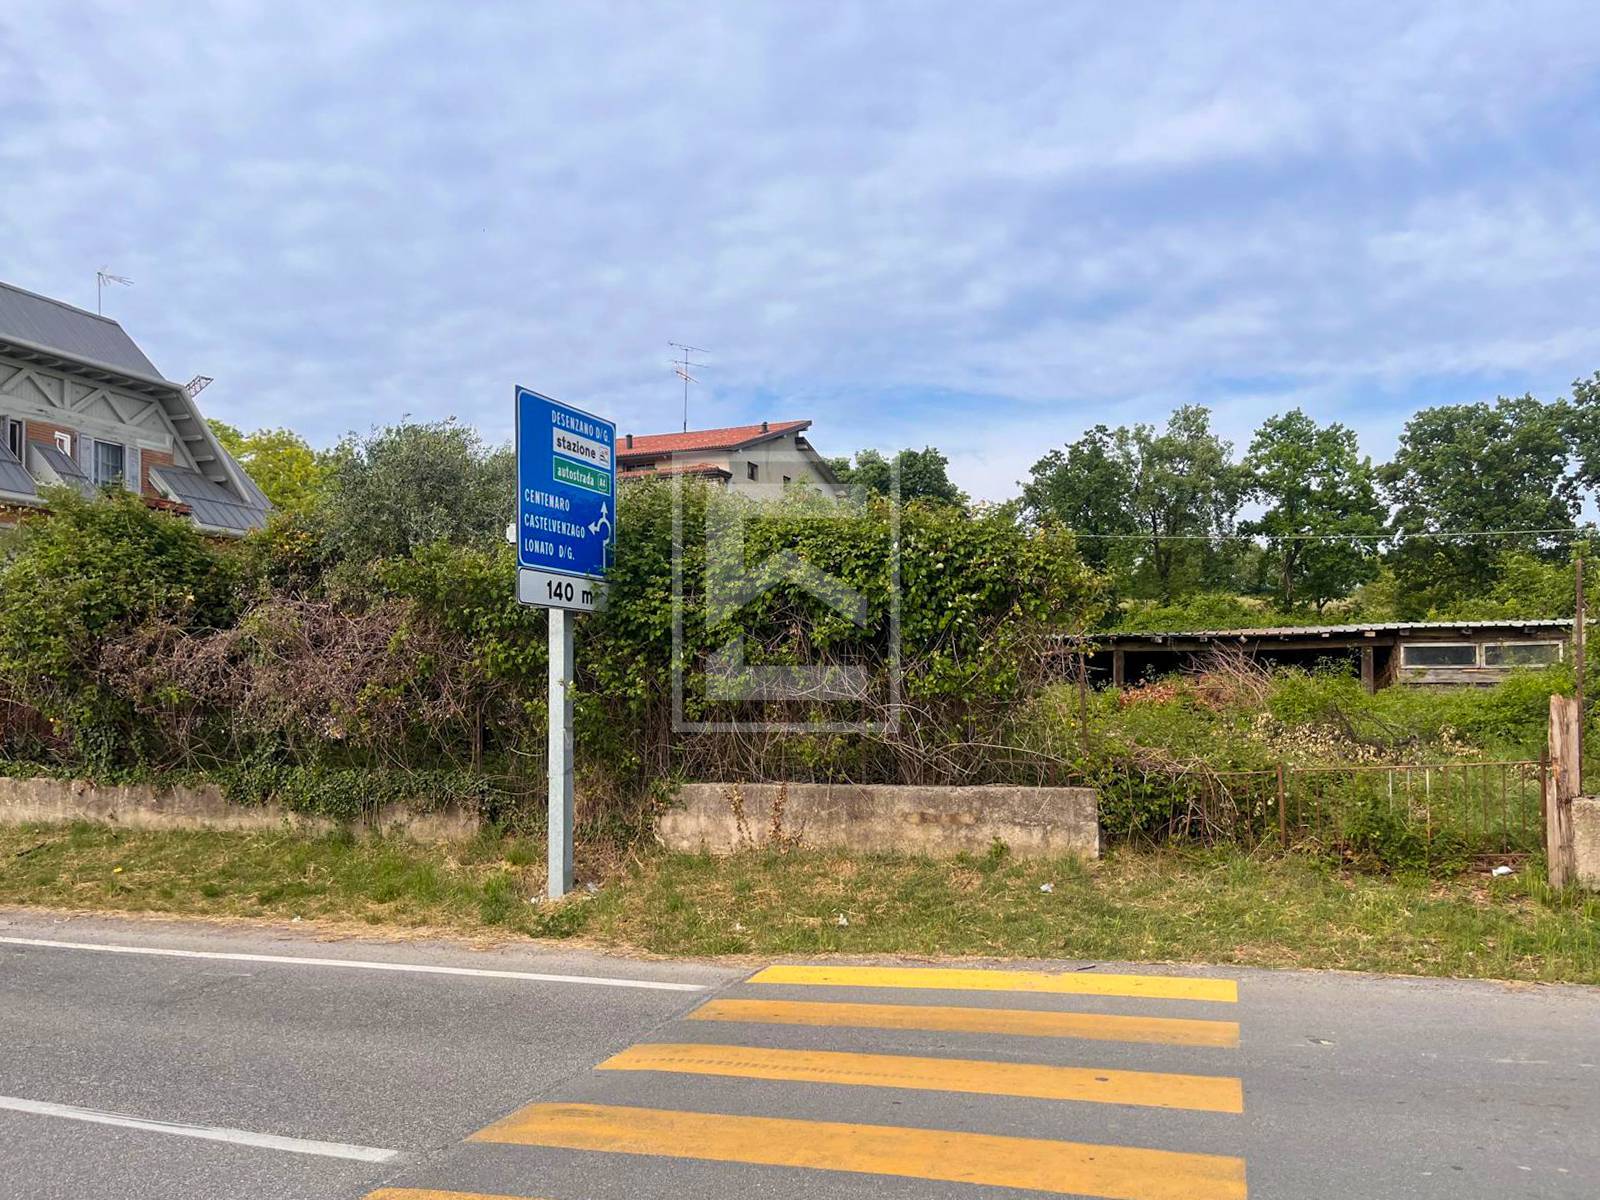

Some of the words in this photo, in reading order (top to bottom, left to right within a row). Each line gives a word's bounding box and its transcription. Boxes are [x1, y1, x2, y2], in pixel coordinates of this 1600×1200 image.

[552, 410, 593, 436] DESENZANO
[557, 436, 596, 459] stazione
[557, 467, 594, 486] autostrada
[524, 488, 570, 512] CENTENARO
[524, 513, 586, 538] CASTELVENZAGO
[524, 538, 554, 556] LONATO
[558, 545, 575, 560] D/G.
[547, 580, 574, 602] 140
[582, 590, 593, 604] m
